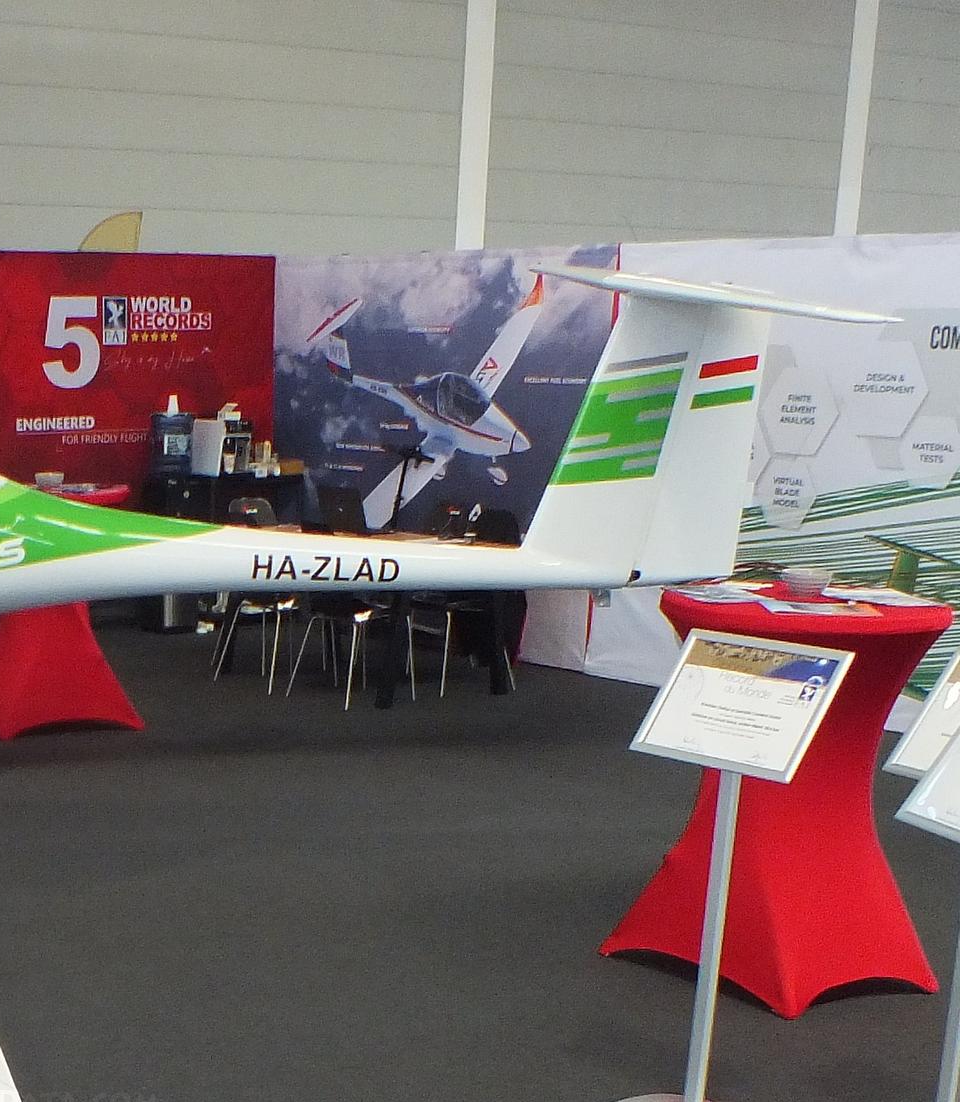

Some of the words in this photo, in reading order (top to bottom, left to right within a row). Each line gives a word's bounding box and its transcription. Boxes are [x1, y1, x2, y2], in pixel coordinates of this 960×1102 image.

[130, 296, 192, 313] WORLD
[131, 313, 211, 330] RECORDS
[42, 296, 101, 389] 5
[865, 373, 898, 383] DESIGN
[853, 383, 916, 395] DEVELOPMENT
[781, 404, 817, 414] ELEMENT
[15, 415, 96, 432] ENGINEERED
[61, 434, 79, 445] FOR
[80, 433, 118, 444] FRIENDLY
[912, 442, 954, 453] MATERIAL
[919, 454, 945, 464] TESTS
[252, 554, 400, 582] HA-ZLAD
